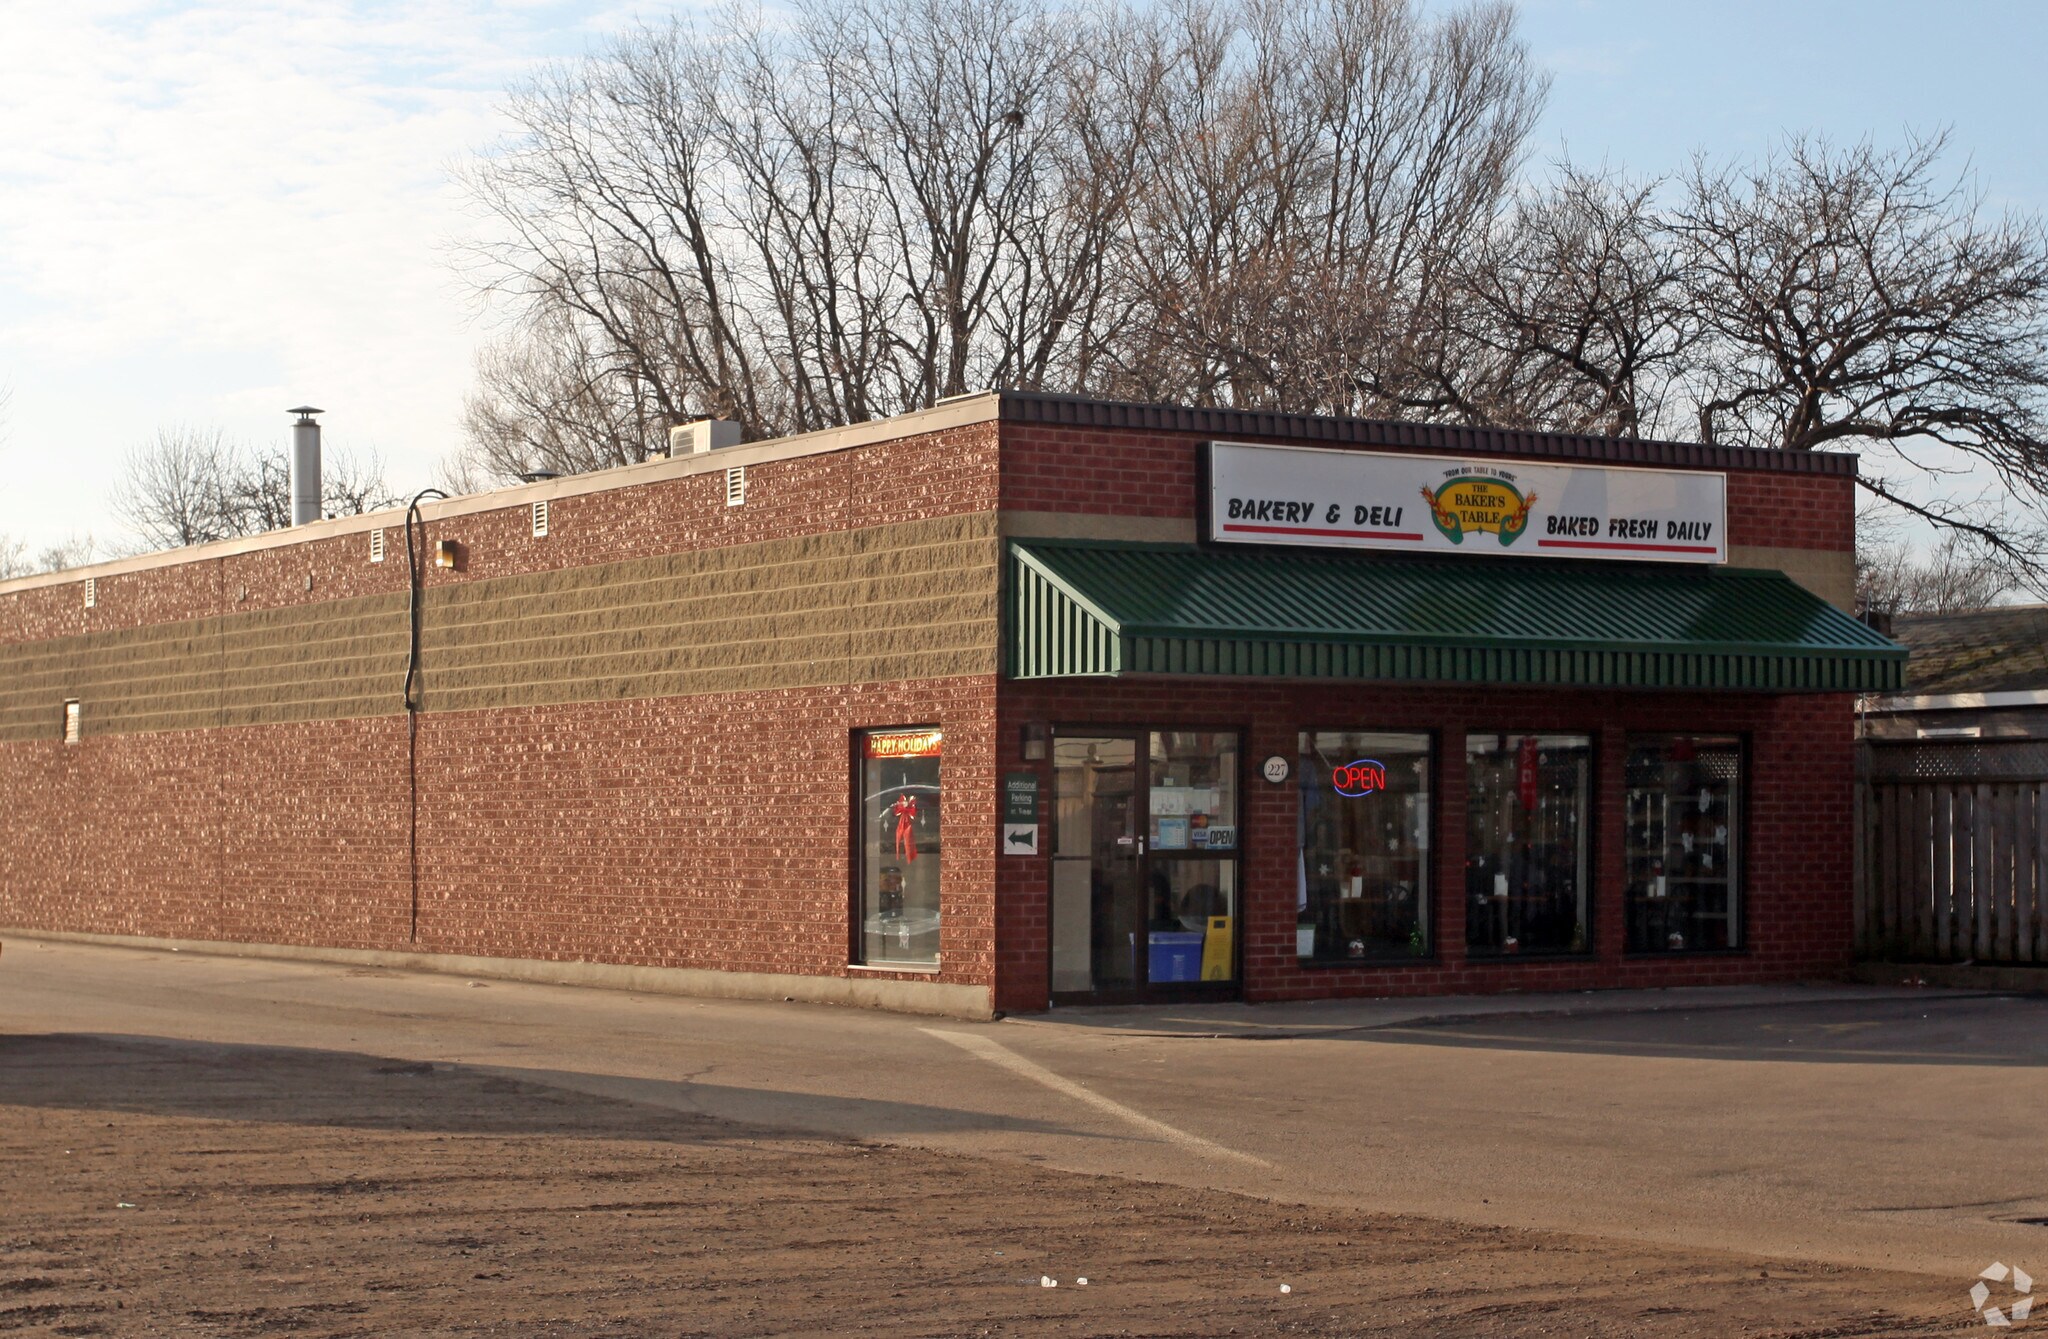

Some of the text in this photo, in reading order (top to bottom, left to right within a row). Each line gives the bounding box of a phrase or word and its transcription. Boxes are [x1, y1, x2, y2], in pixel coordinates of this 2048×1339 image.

[1461, 467, 1472, 475] OUR
[1474, 466, 1489, 475] TABLE
[1490, 467, 1497, 476] TO
[1472, 484, 1488, 492] THE
[1455, 493, 1506, 508] BAKER'S
[1228, 497, 1403, 527] BAKERY & DELI
[1460, 510, 1500, 524] TABLE
[1546, 514, 1712, 542] BAKED FRESH DAILY
[871, 737, 938, 754] HAPPY HOLIDAYS
[1267, 763, 1286, 776] 227
[1332, 765, 1386, 790] OPEN
[1007, 780, 1037, 791] Additional
[1011, 793, 1032, 804] Parking
[1193, 830, 1207, 838] VISA
[1209, 830, 1234, 845] OPEN
